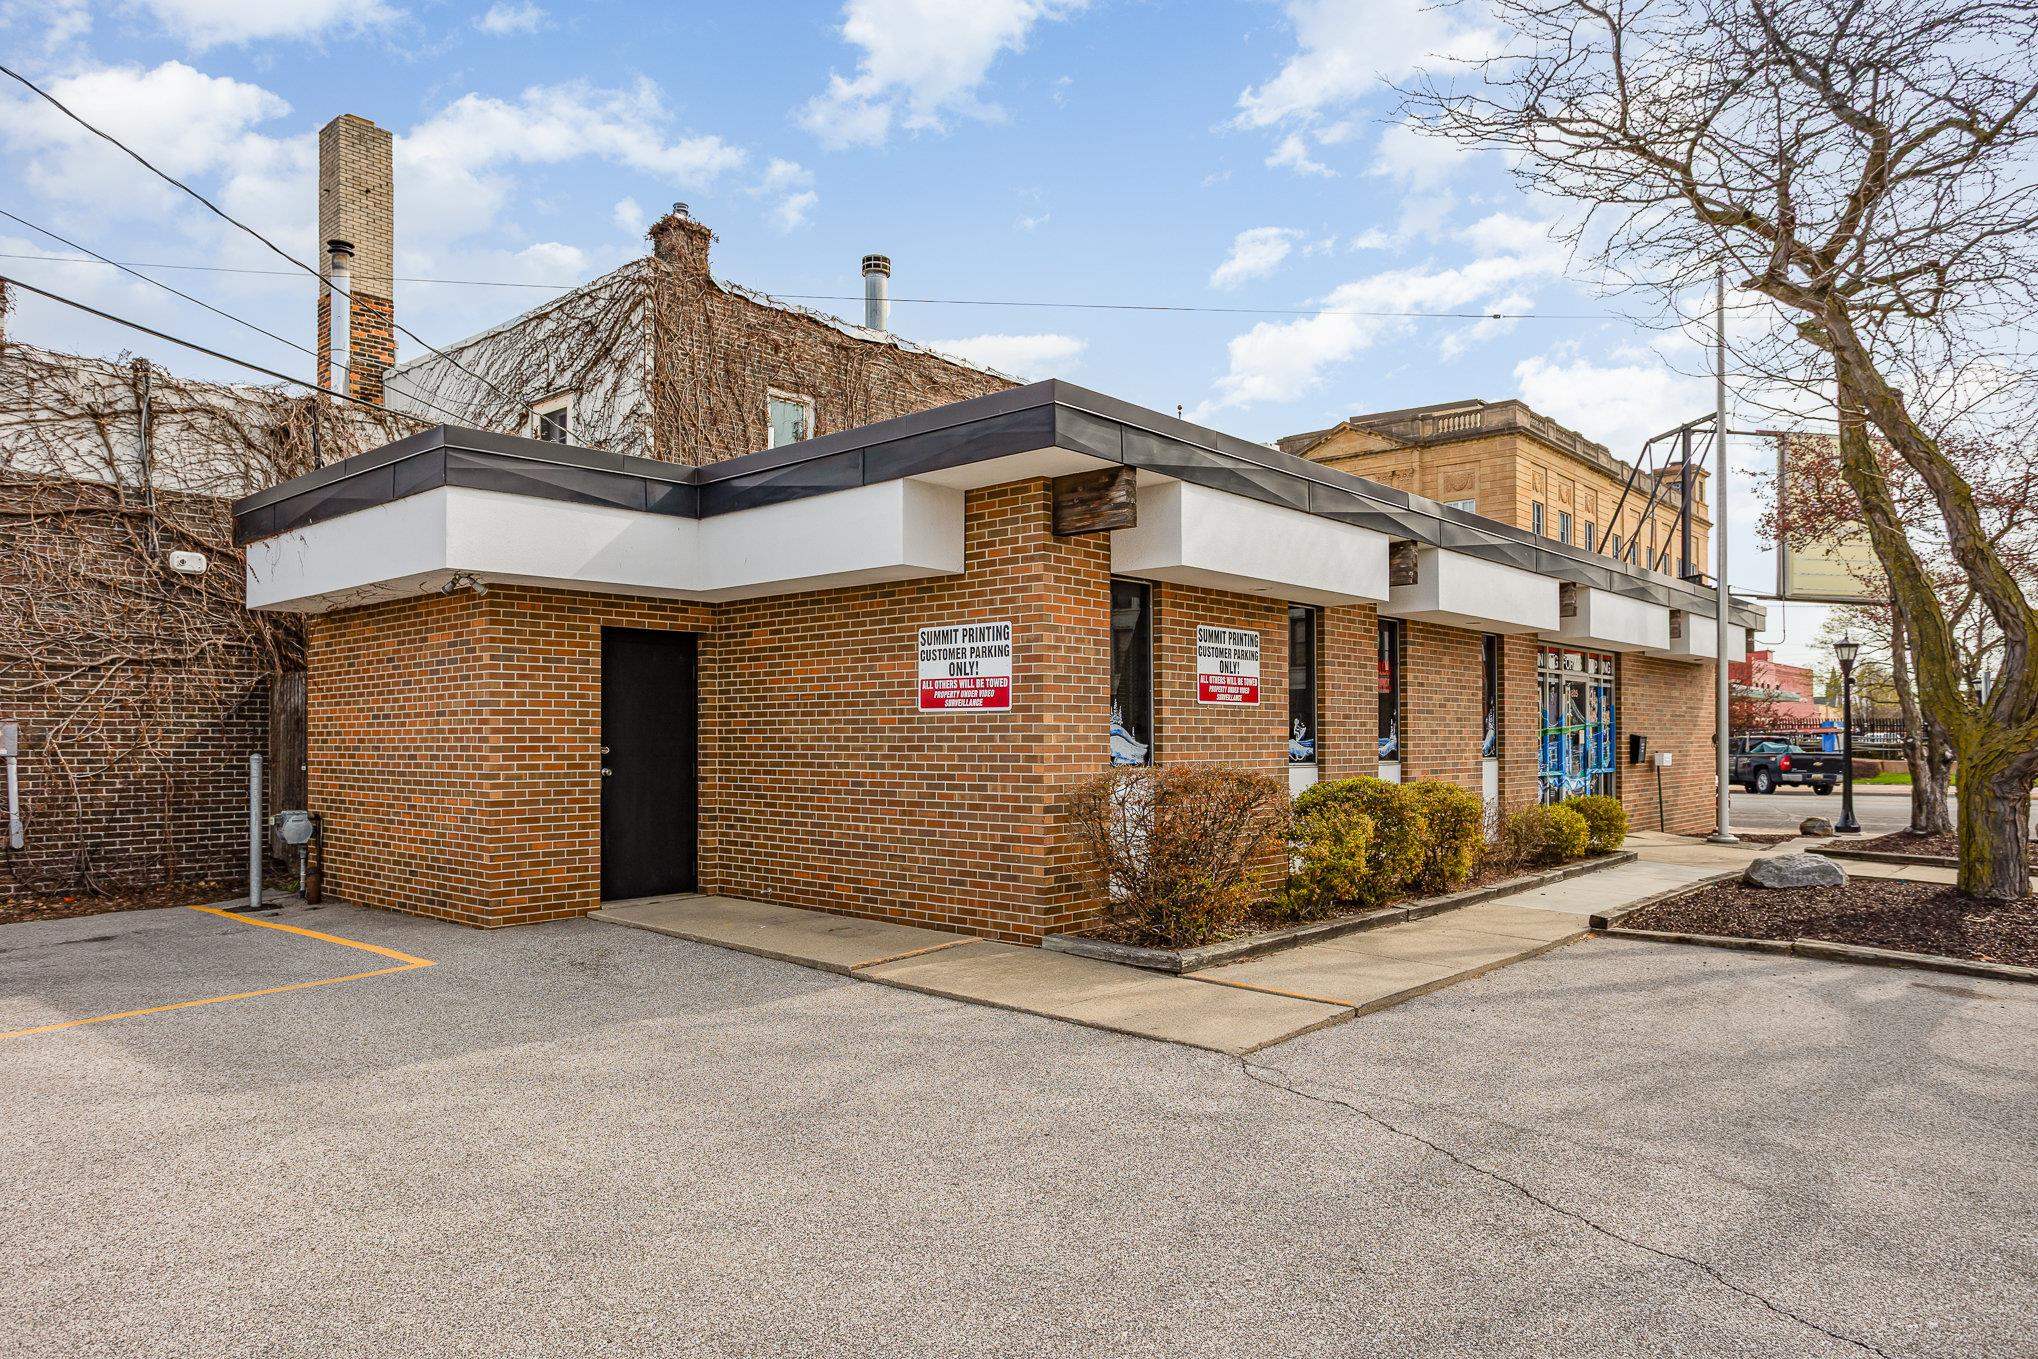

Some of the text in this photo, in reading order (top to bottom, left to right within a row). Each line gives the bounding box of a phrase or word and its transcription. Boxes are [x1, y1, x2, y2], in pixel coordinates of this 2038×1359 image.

[920, 625, 1010, 646] SUMMIT PRINTING
[1198, 628, 1259, 648] SUMMIT PRINTING
[920, 644, 1010, 661] CUSTOMER PARKING
[1198, 646, 1259, 661] CUSTOMER PARKING
[949, 661, 979, 676] ONLY!
[1219, 660, 1240, 675] ONLY!
[922, 678, 1008, 690] ALL OTHERS WILL BE TOWED
[1200, 675, 1209, 684] ALL
[1209, 676, 1226, 685] OTHERS
[1226, 676, 1237, 685] WILL
[934, 690, 960, 699] PROPERTY
[944, 699, 983, 707] SURVEILLANCE
